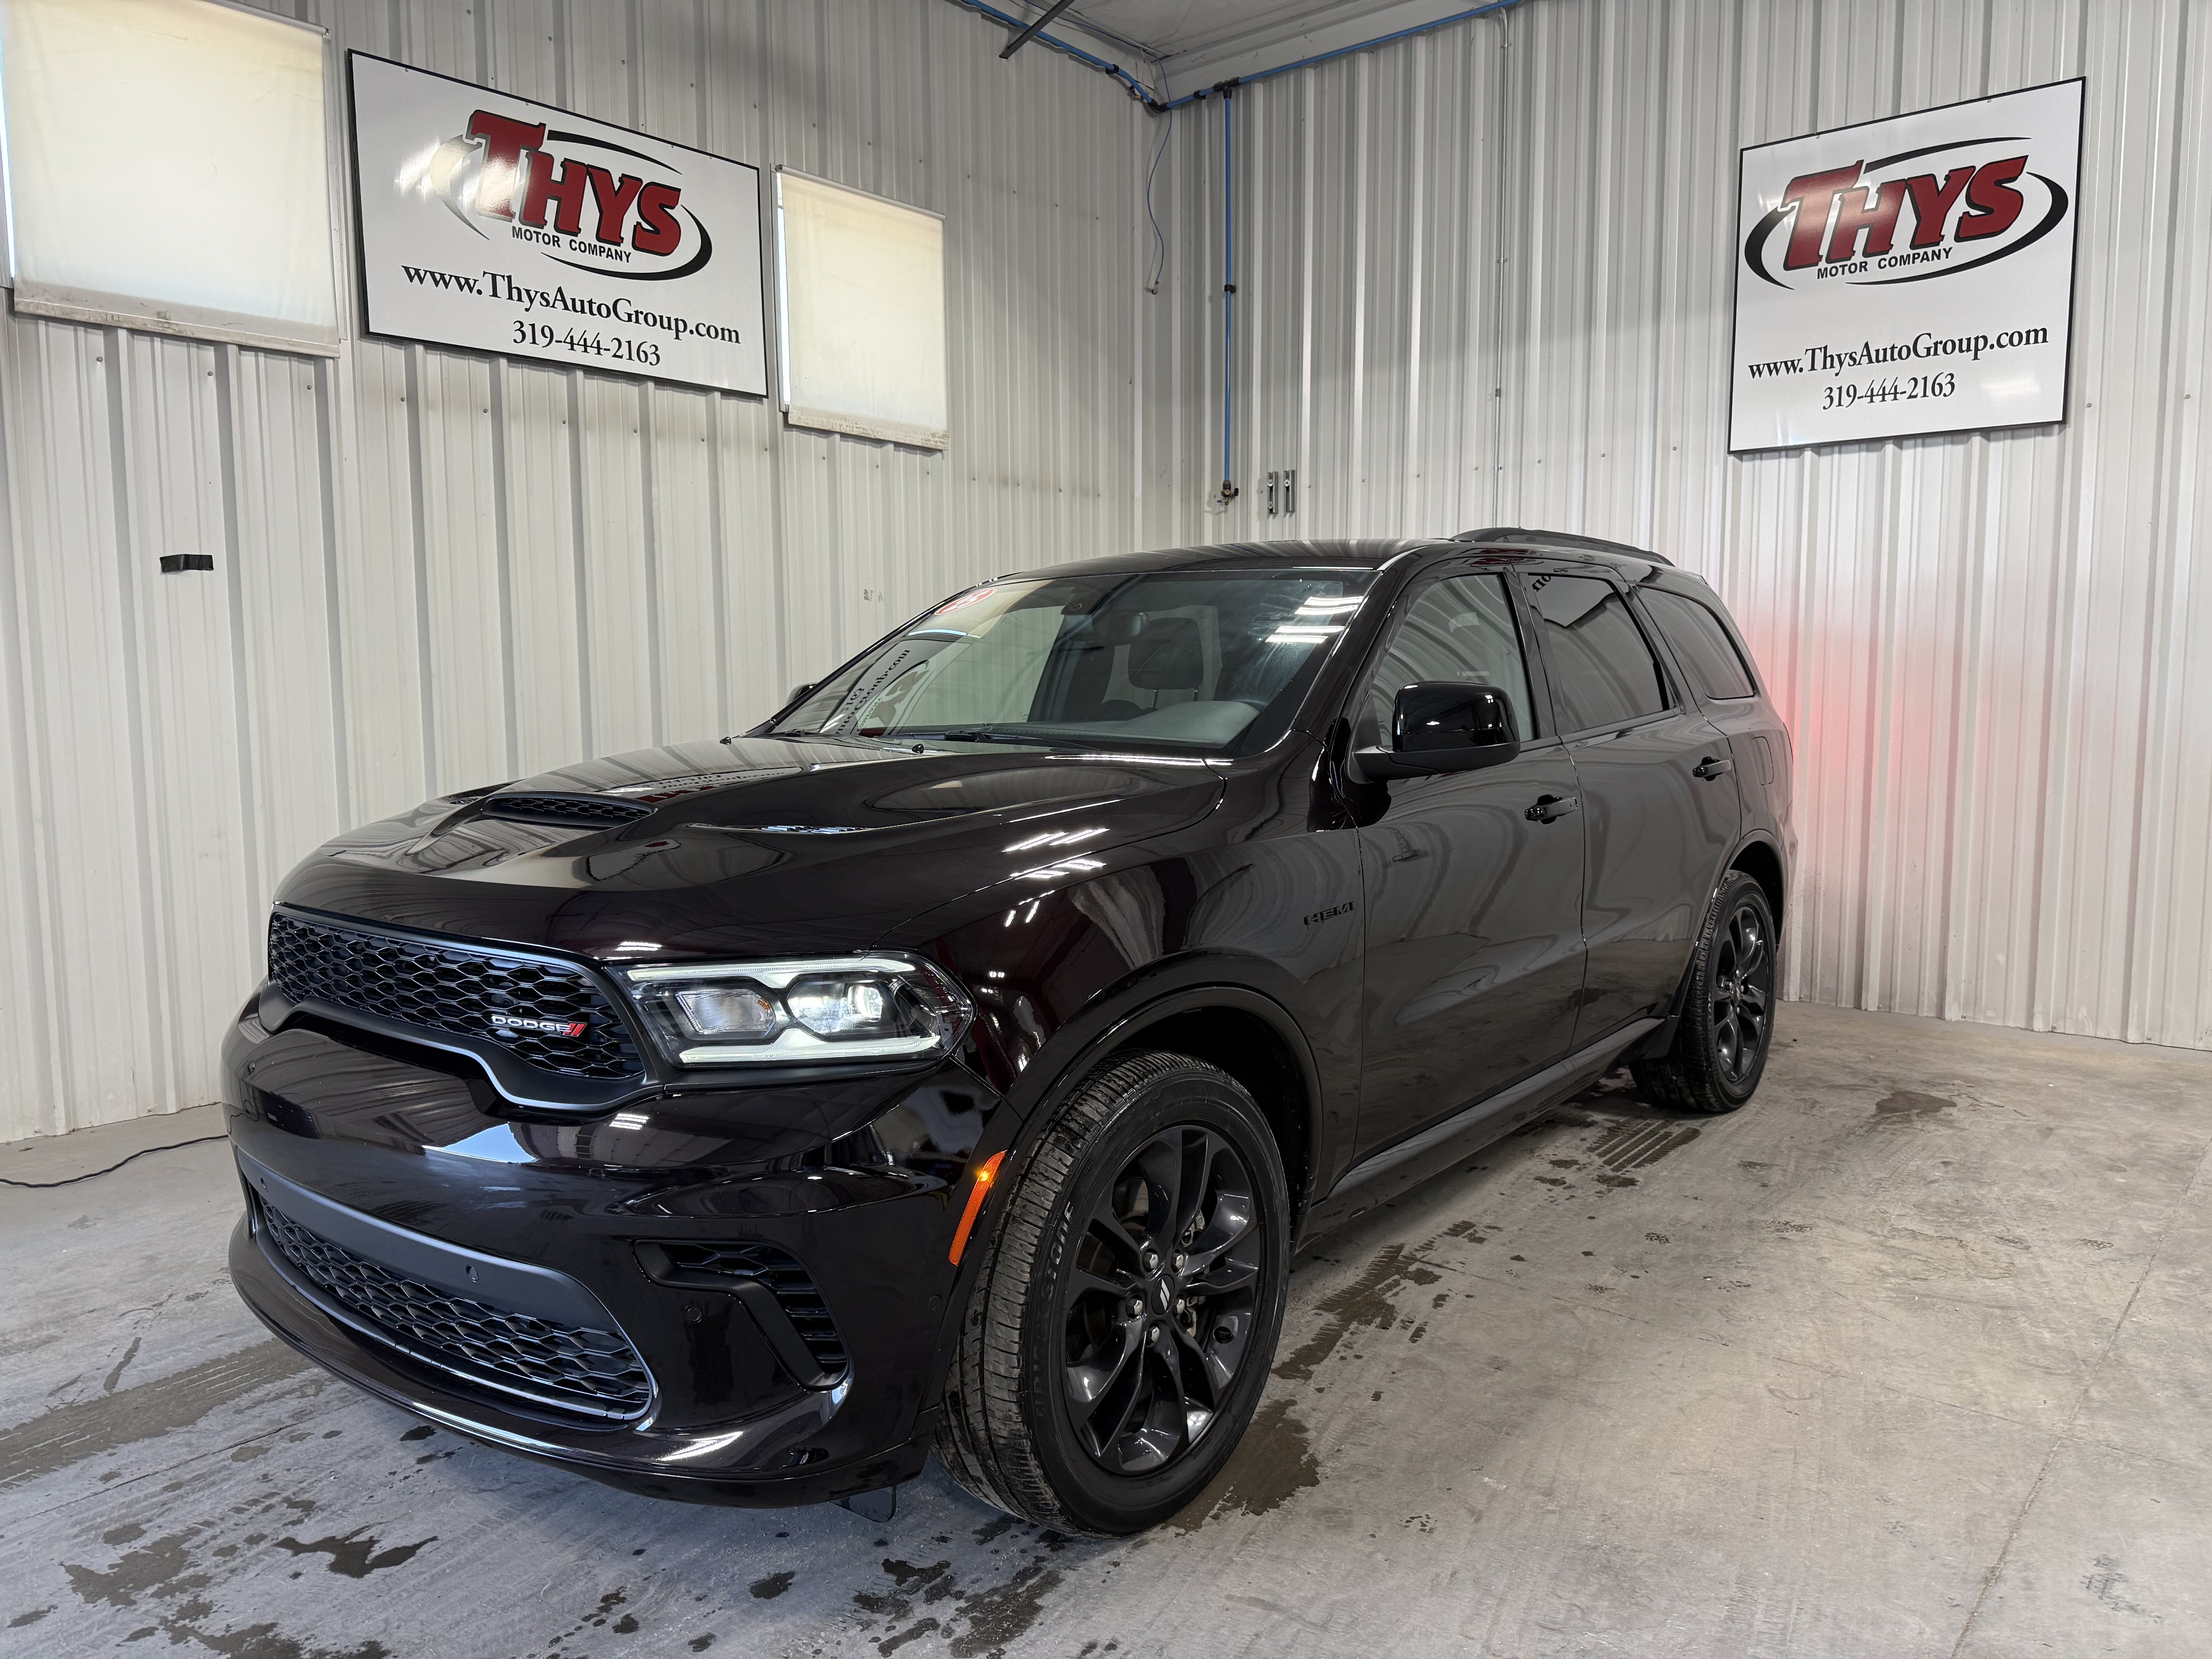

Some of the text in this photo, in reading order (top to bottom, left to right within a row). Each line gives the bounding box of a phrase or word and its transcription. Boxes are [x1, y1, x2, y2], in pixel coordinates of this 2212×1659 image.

[467, 110, 681, 256] THYS
[1782, 155, 2029, 271] THYS
[512, 225, 632, 263] MOTOR COMPANY
[1817, 247, 1953, 279] MOTOR COMPANY
[402, 265, 741, 344] www.ThysAutoGroup.com
[513, 320, 661, 366] 319-444-2163
[1748, 327, 2048, 379] www.ThysAutoGroup.com
[1823, 373, 1955, 410] 319-444-2163
[1304, 901, 1354, 926] HEMI
[491, 1015, 572, 1032] DODGE
